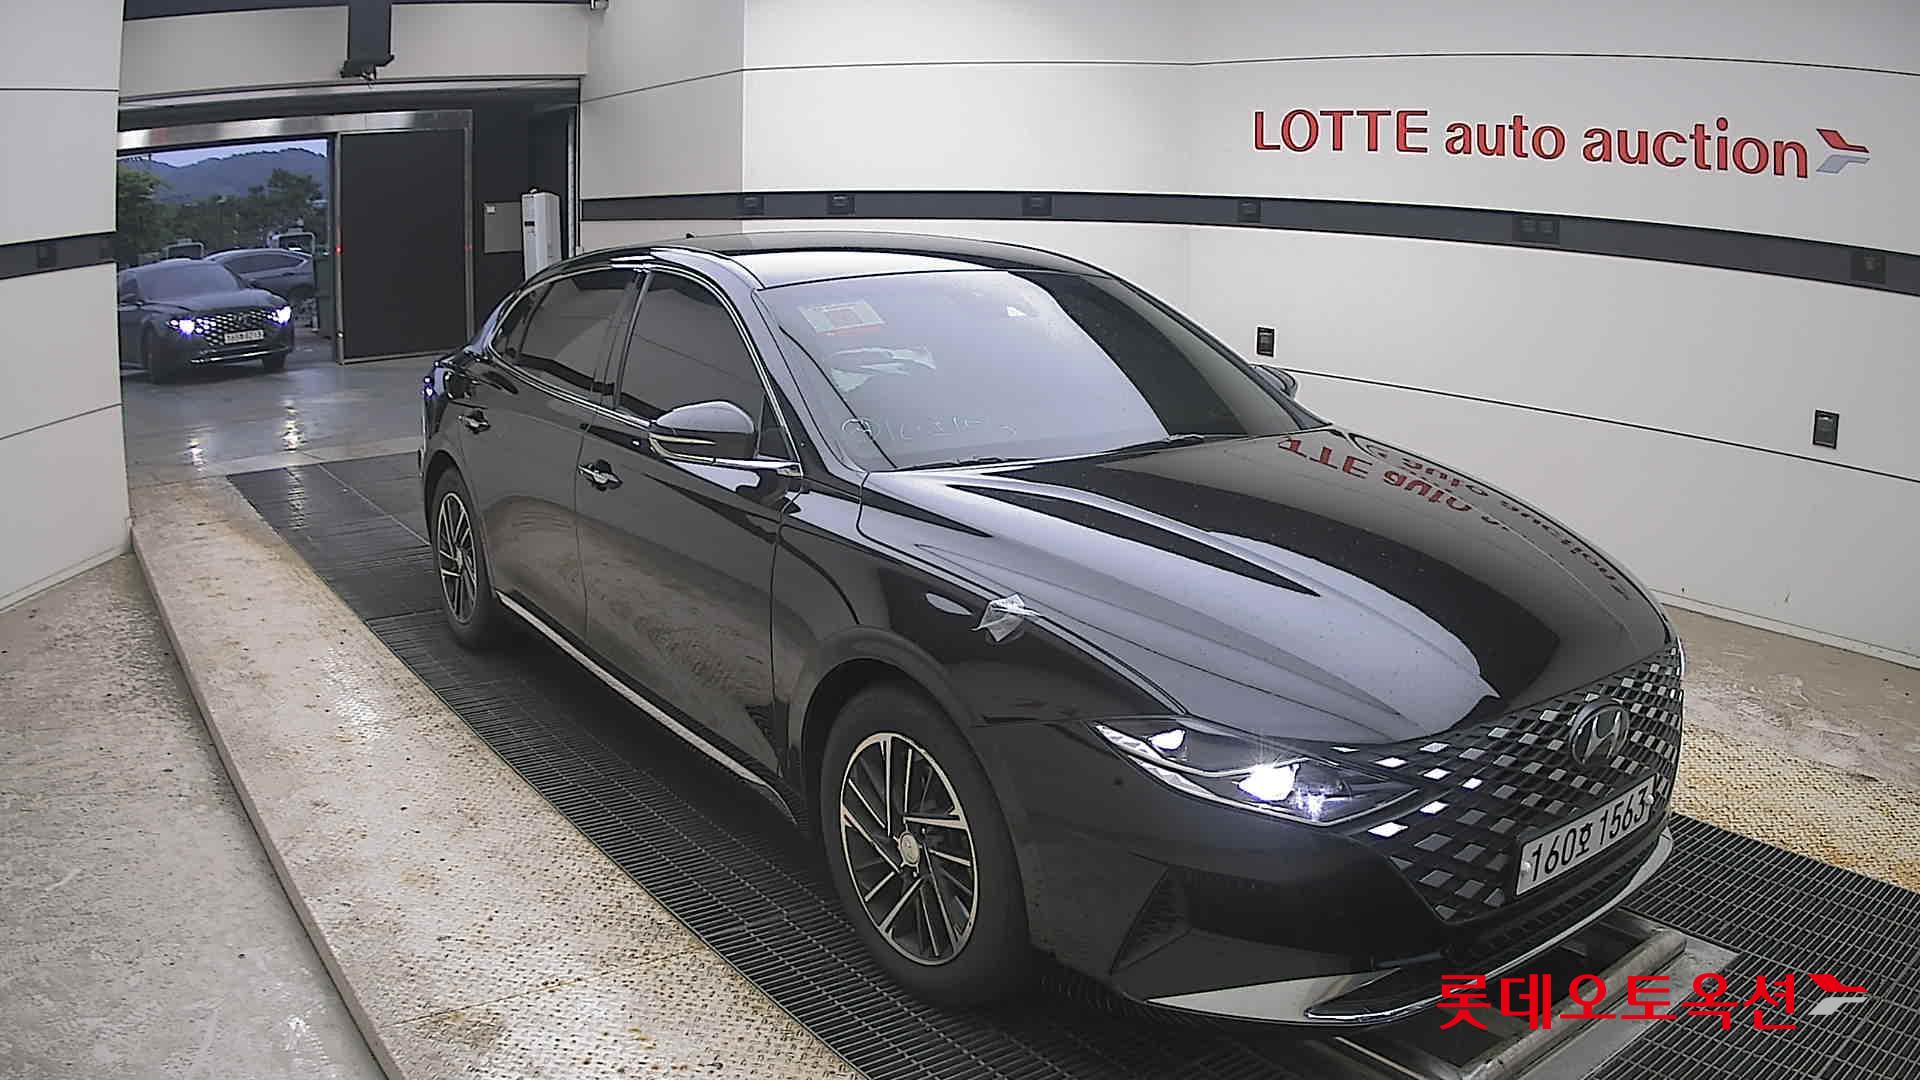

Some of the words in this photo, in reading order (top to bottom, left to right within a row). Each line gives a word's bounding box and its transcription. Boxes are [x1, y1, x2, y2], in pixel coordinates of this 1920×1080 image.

[1253, 108, 1429, 153] LOTTE
[1444, 114, 1567, 160] auto
[1582, 116, 1809, 179] auction
[1599, 785, 1649, 845] 1563
